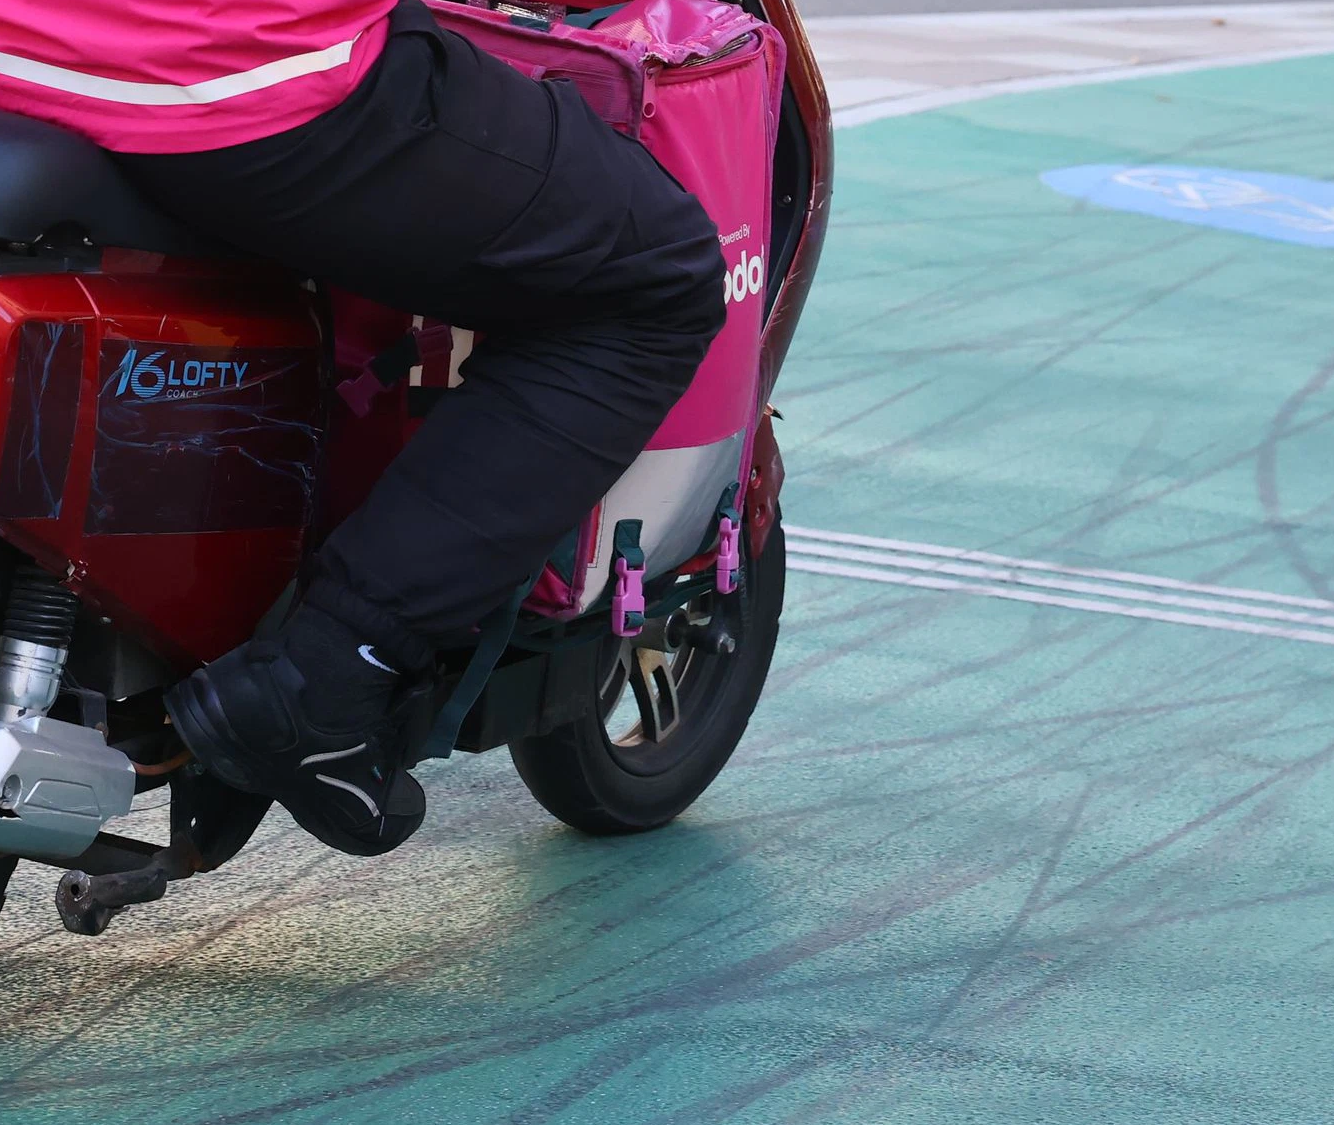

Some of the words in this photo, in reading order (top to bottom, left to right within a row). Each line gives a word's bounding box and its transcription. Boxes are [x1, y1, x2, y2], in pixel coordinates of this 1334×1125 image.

[742, 223, 751, 239] By
[115, 349, 167, 398] 16
[167, 360, 249, 388] LOFTY
